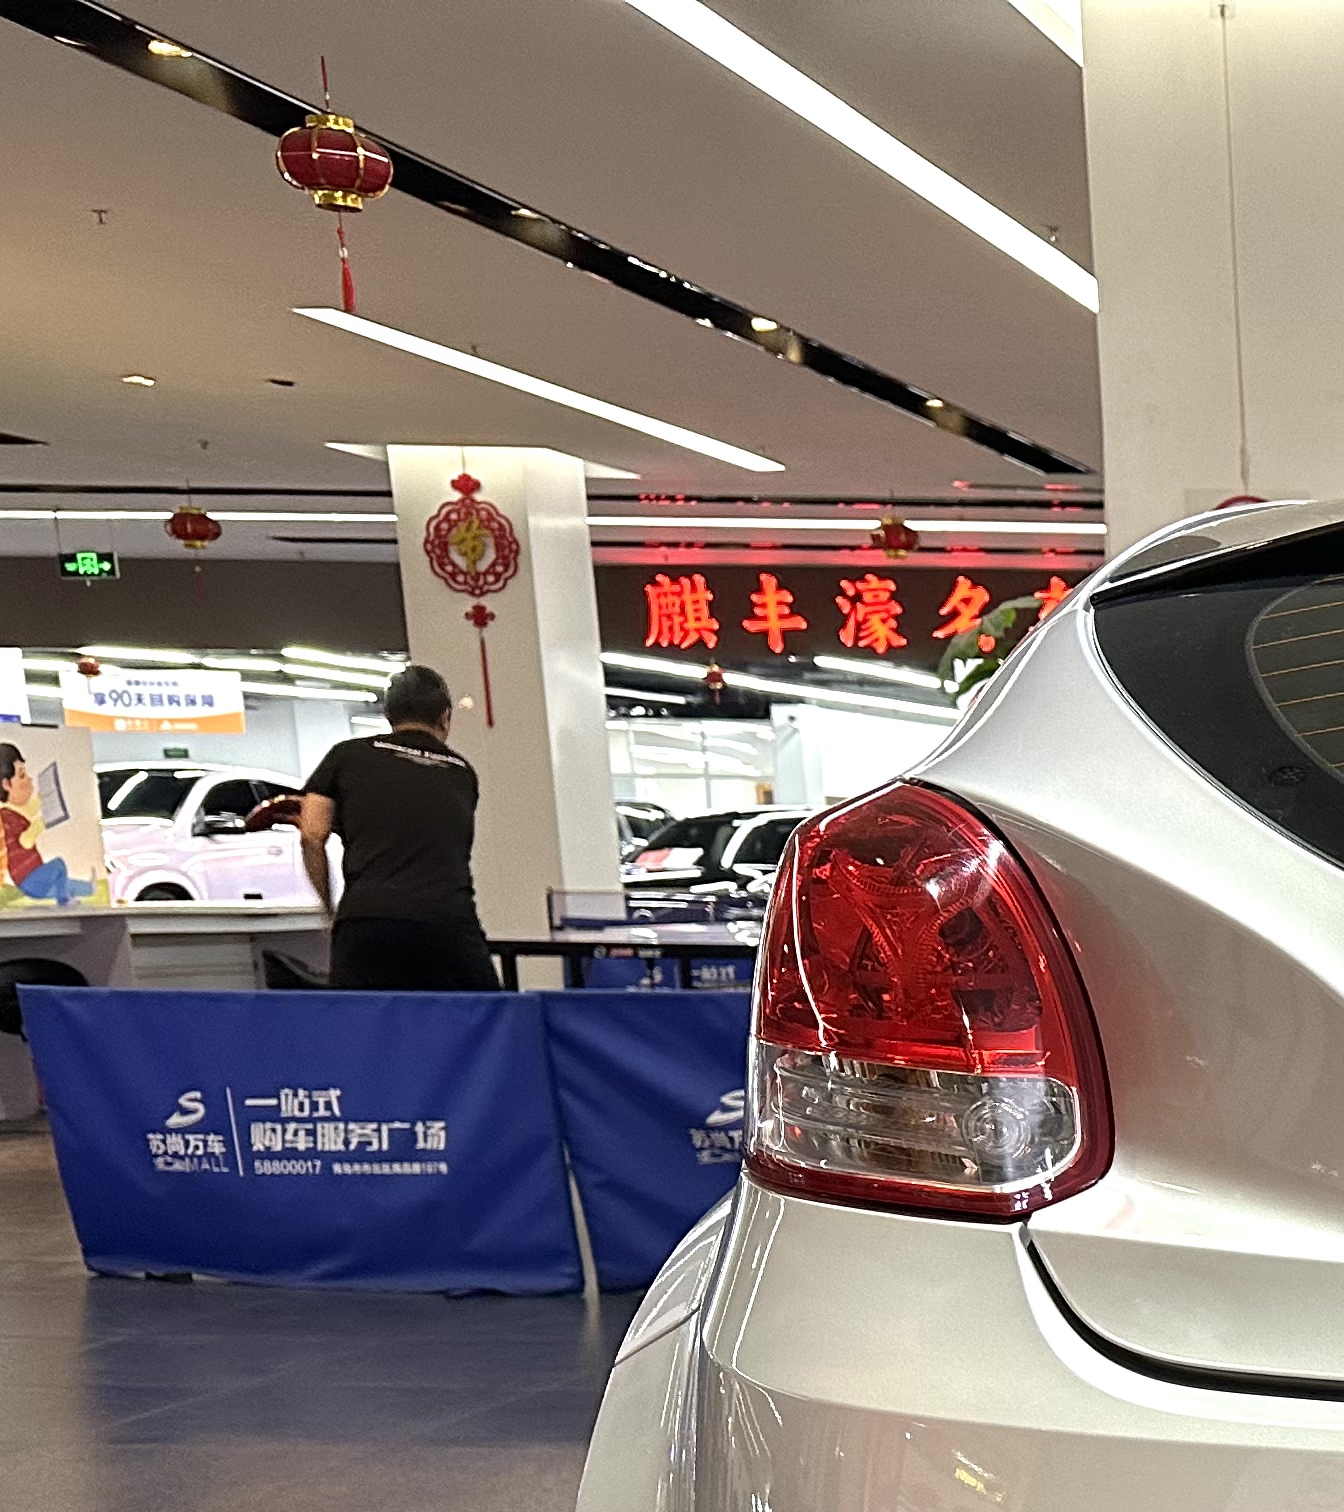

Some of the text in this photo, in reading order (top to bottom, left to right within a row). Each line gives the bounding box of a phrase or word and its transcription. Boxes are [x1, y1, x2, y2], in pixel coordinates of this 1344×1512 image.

[244, 1087, 342, 1118] 一站式
[250, 1120, 446, 1151] 购车服务广场
